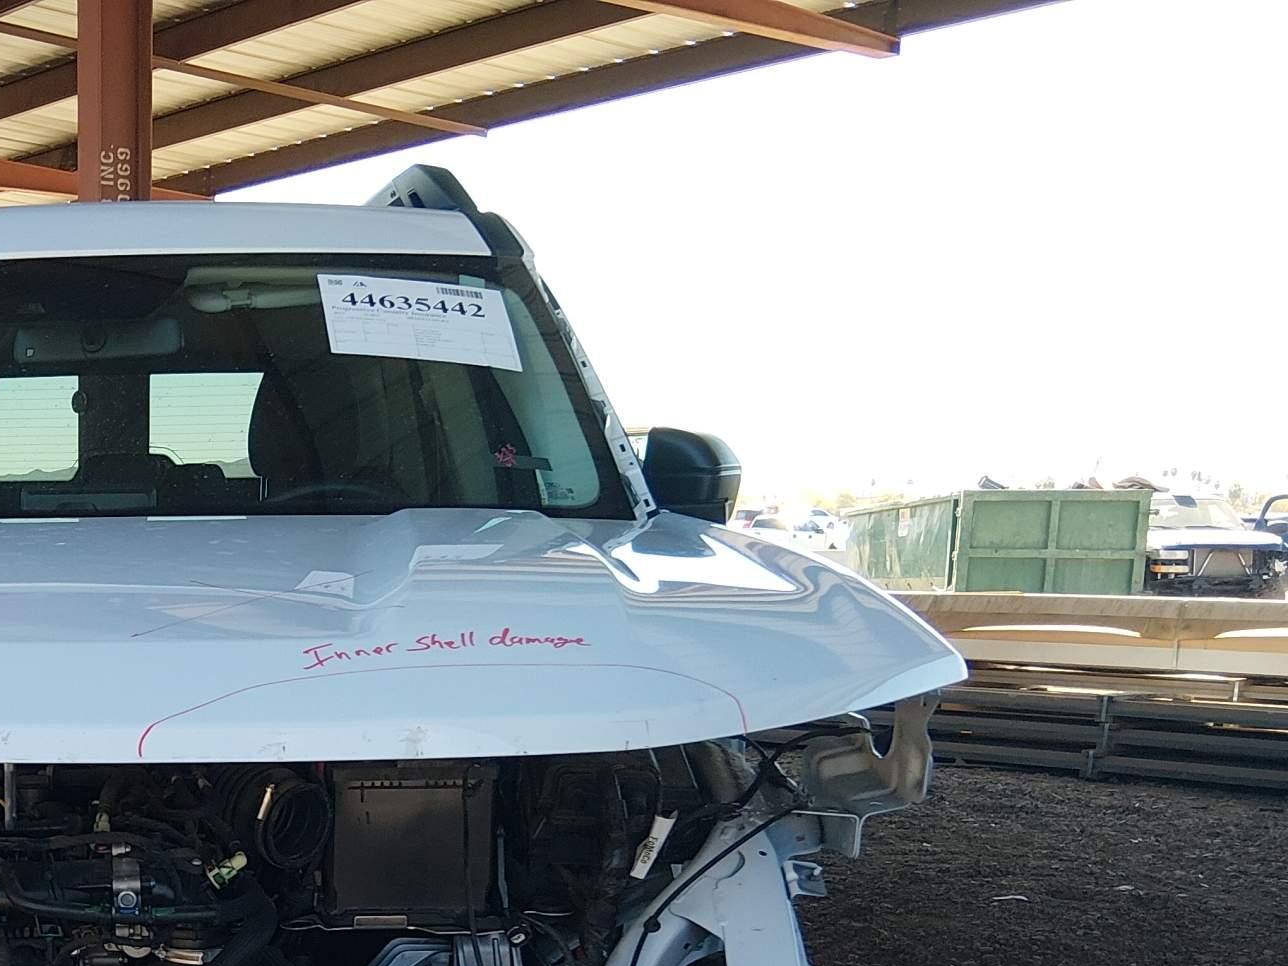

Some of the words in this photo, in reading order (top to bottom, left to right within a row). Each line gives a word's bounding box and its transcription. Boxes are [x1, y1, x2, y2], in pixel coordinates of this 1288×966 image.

[99, 143, 114, 186] INC.
[341, 291, 486, 318] 44635442
[303, 642, 398, 670] Inner
[488, 627, 592, 649] damage
